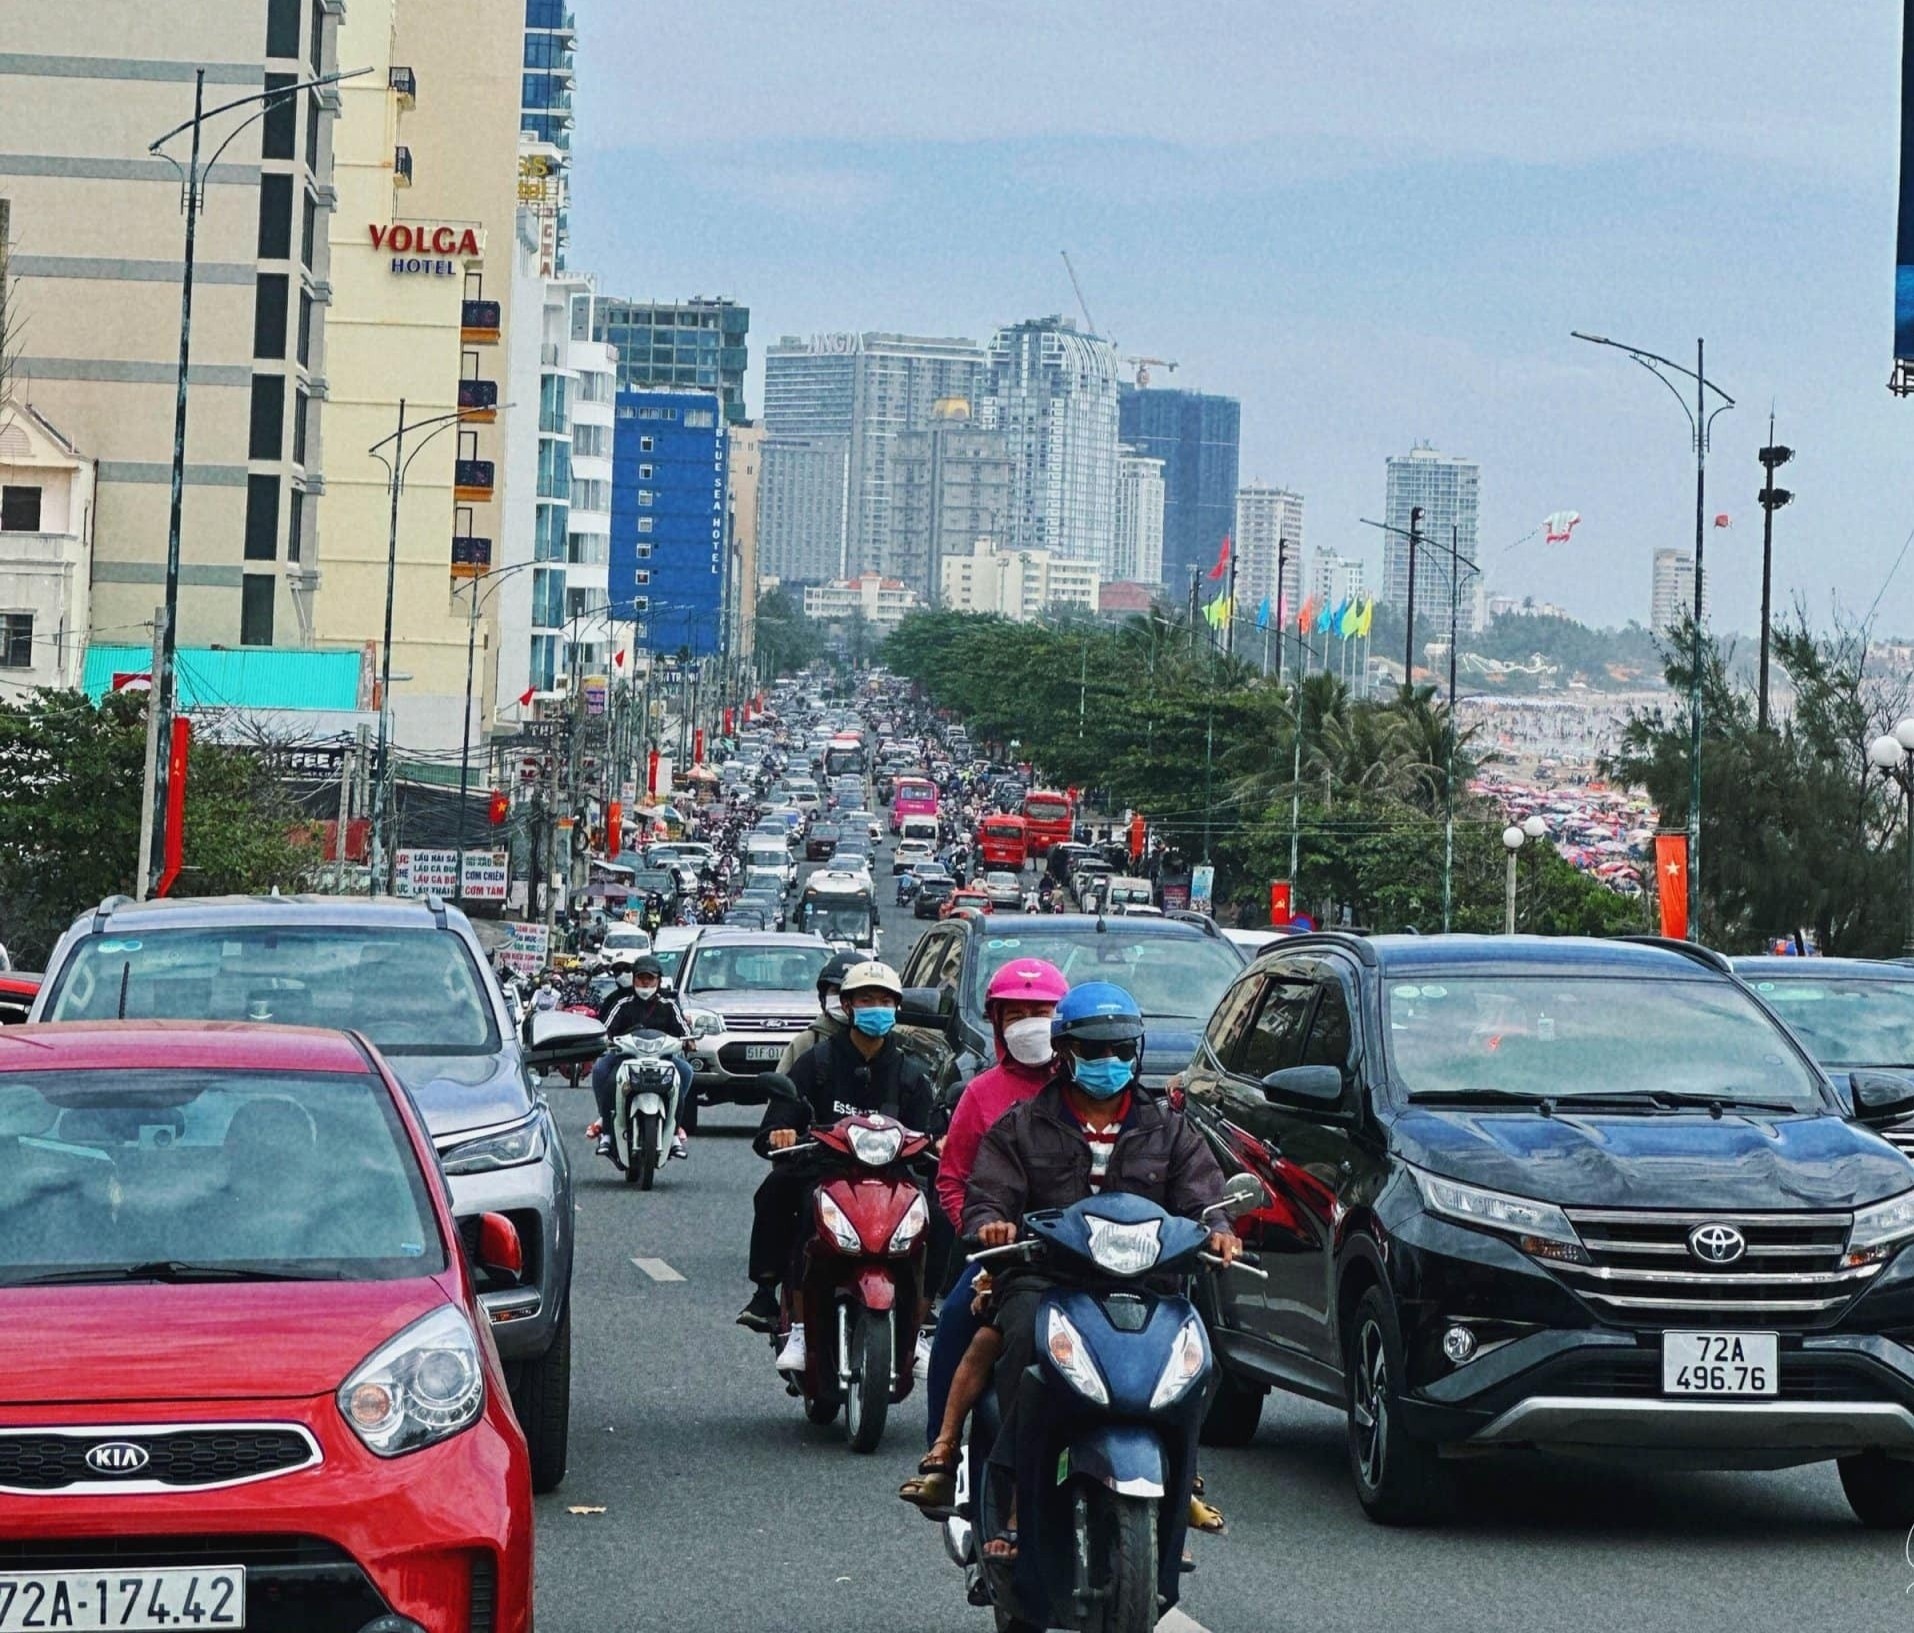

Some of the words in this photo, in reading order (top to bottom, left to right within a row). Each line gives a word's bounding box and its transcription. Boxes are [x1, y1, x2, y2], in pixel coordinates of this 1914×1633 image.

[368, 224, 479, 255] VOLGA
[391, 258, 456, 275] HOTEL
[715, 428, 724, 472] BLUE
[713, 478, 722, 510] SEA
[711, 518, 721, 575] HOTEL
[1696, 1336, 1745, 1362] 72A
[1676, 1365, 1766, 1391] 496.76
[96, 1448, 138, 1467] KIA
[0, 1576, 234, 1627] 72A-174.42
